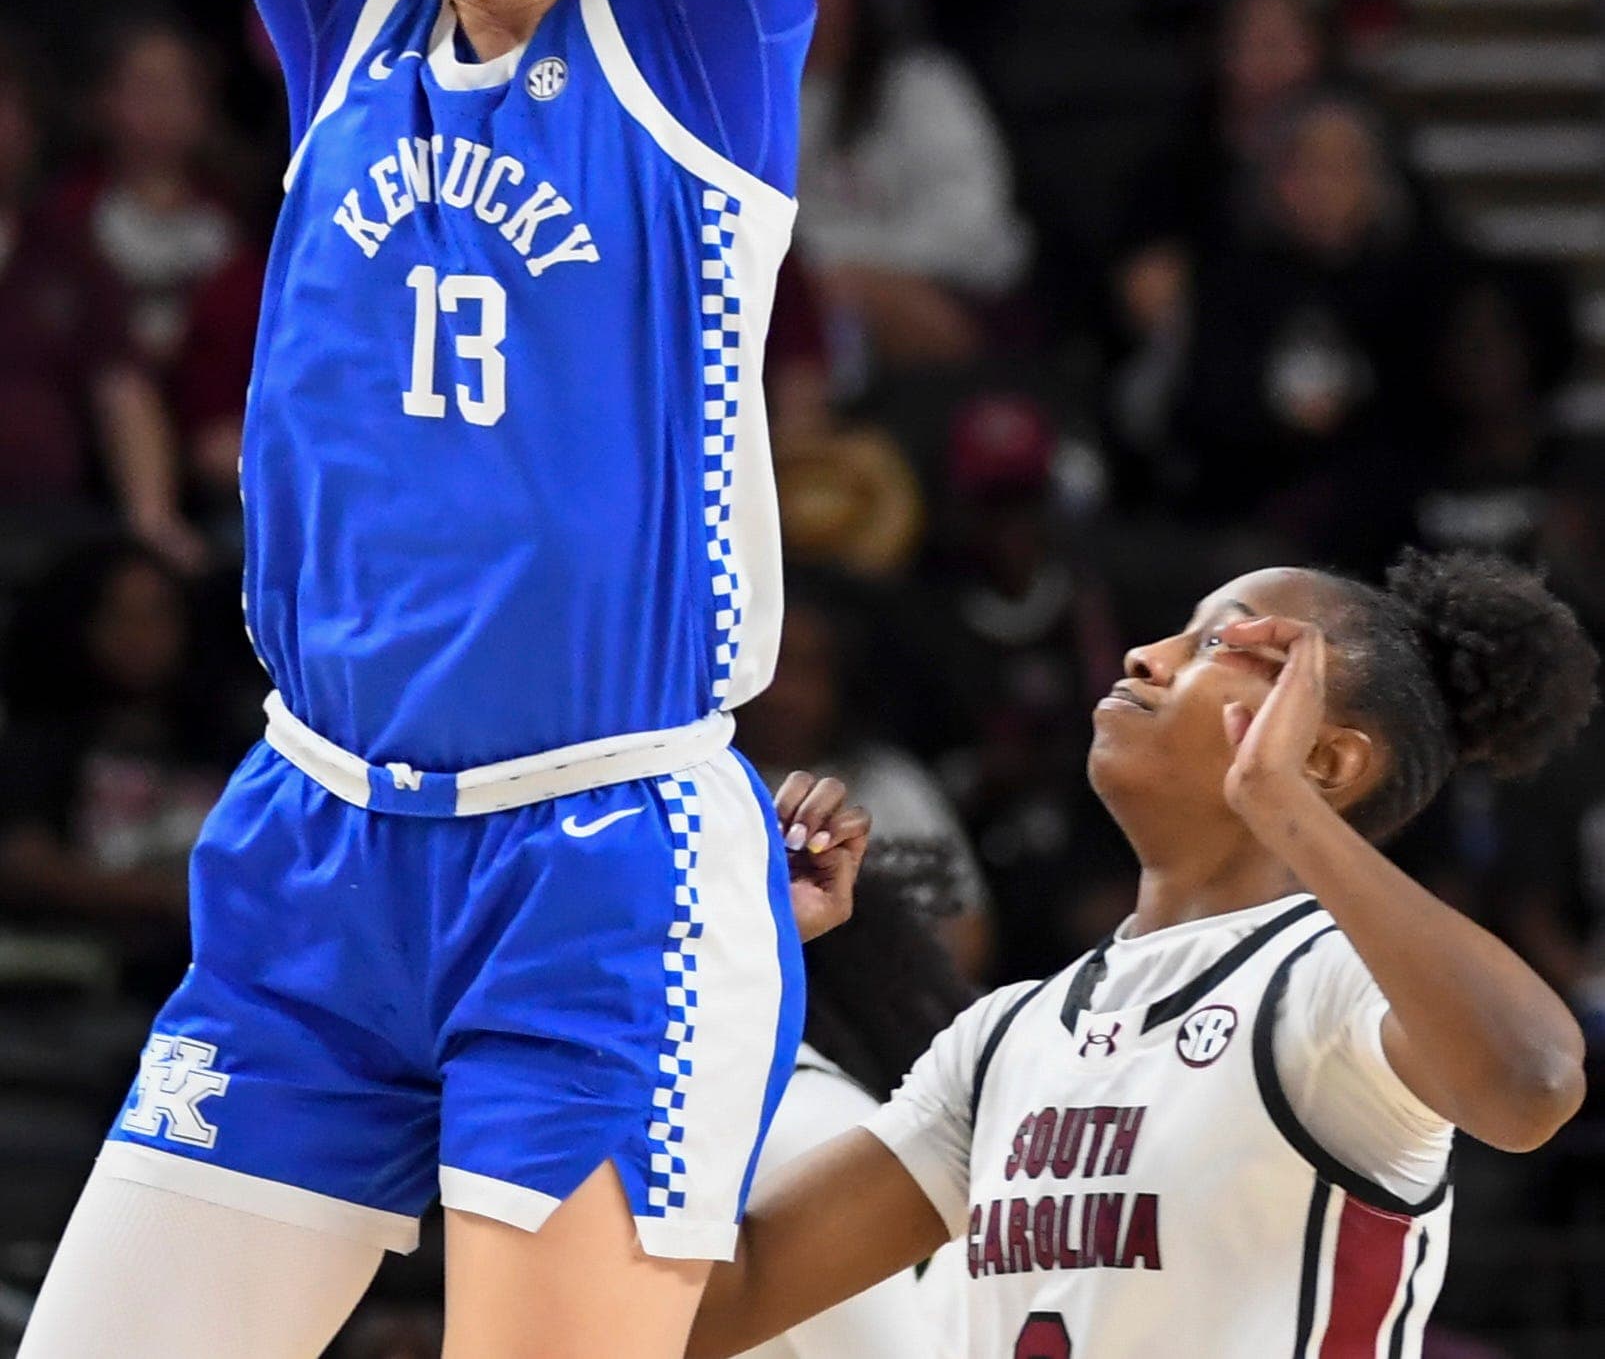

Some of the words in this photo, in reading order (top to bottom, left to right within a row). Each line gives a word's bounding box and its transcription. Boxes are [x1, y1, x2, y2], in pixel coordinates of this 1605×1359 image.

[528, 60, 565, 98] SEC
[402, 265, 507, 426] 13
[1004, 1105, 1147, 1181] SOUTH
[967, 1192, 1162, 1279] CAROLINA
